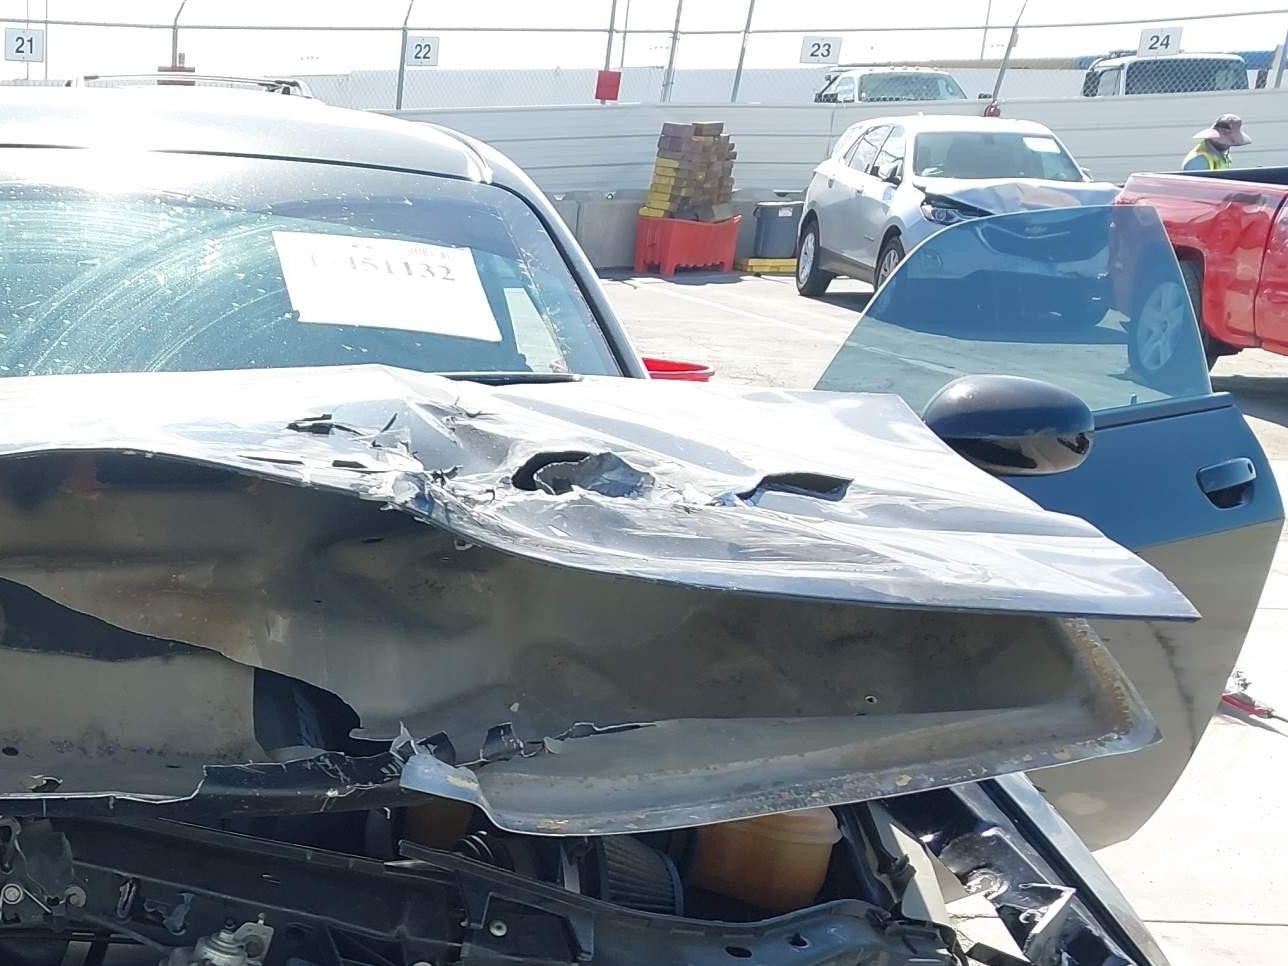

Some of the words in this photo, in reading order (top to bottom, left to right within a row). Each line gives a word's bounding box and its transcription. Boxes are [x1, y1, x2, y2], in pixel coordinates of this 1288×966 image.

[15, 36, 33, 54] 21
[809, 42, 832, 58] 23
[1148, 34, 1171, 50] 24
[414, 43, 432, 60] 22
